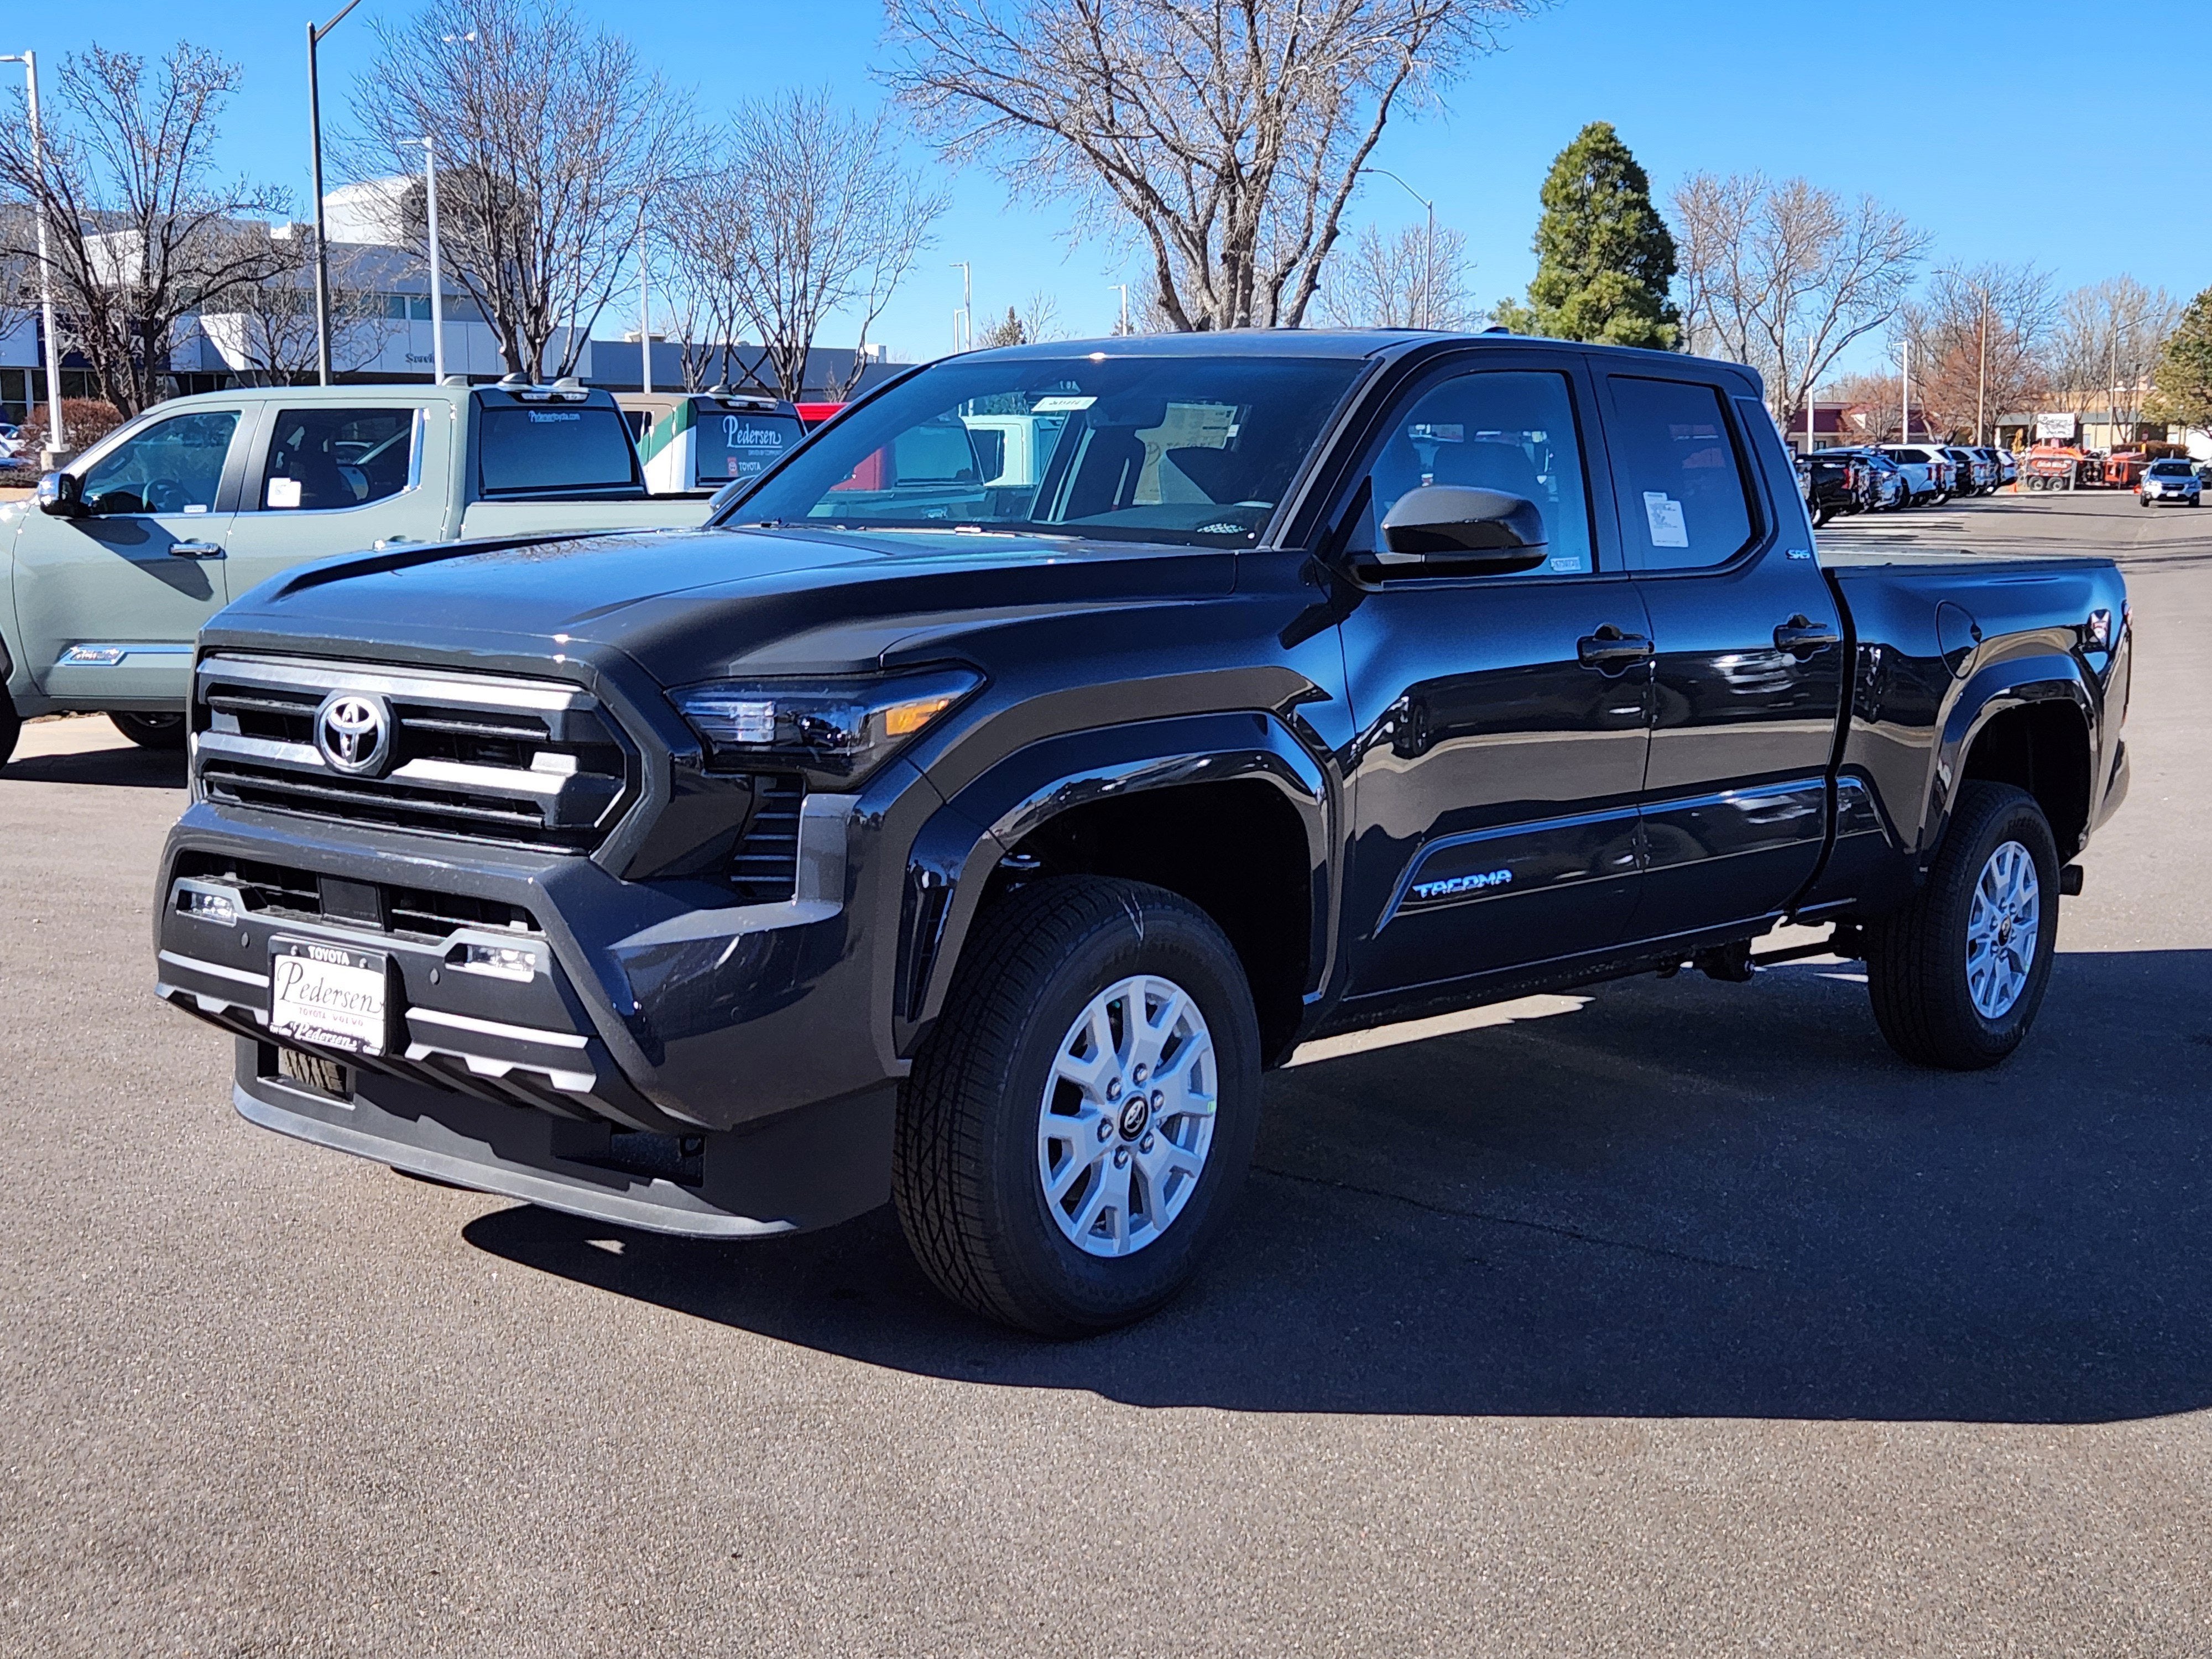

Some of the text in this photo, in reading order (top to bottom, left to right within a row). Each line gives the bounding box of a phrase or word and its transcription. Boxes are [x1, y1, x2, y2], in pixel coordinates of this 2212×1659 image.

[723, 415, 782, 447] Pedersen
[739, 462, 761, 471] TOYOTA
[1412, 869, 1512, 898] TACOMA
[307, 946, 350, 966] TOYOTA
[277, 961, 385, 1013] Pedersen
[299, 1007, 363, 1026] TOYOTA VOLVO
[290, 1022, 358, 1052] Pedersen
